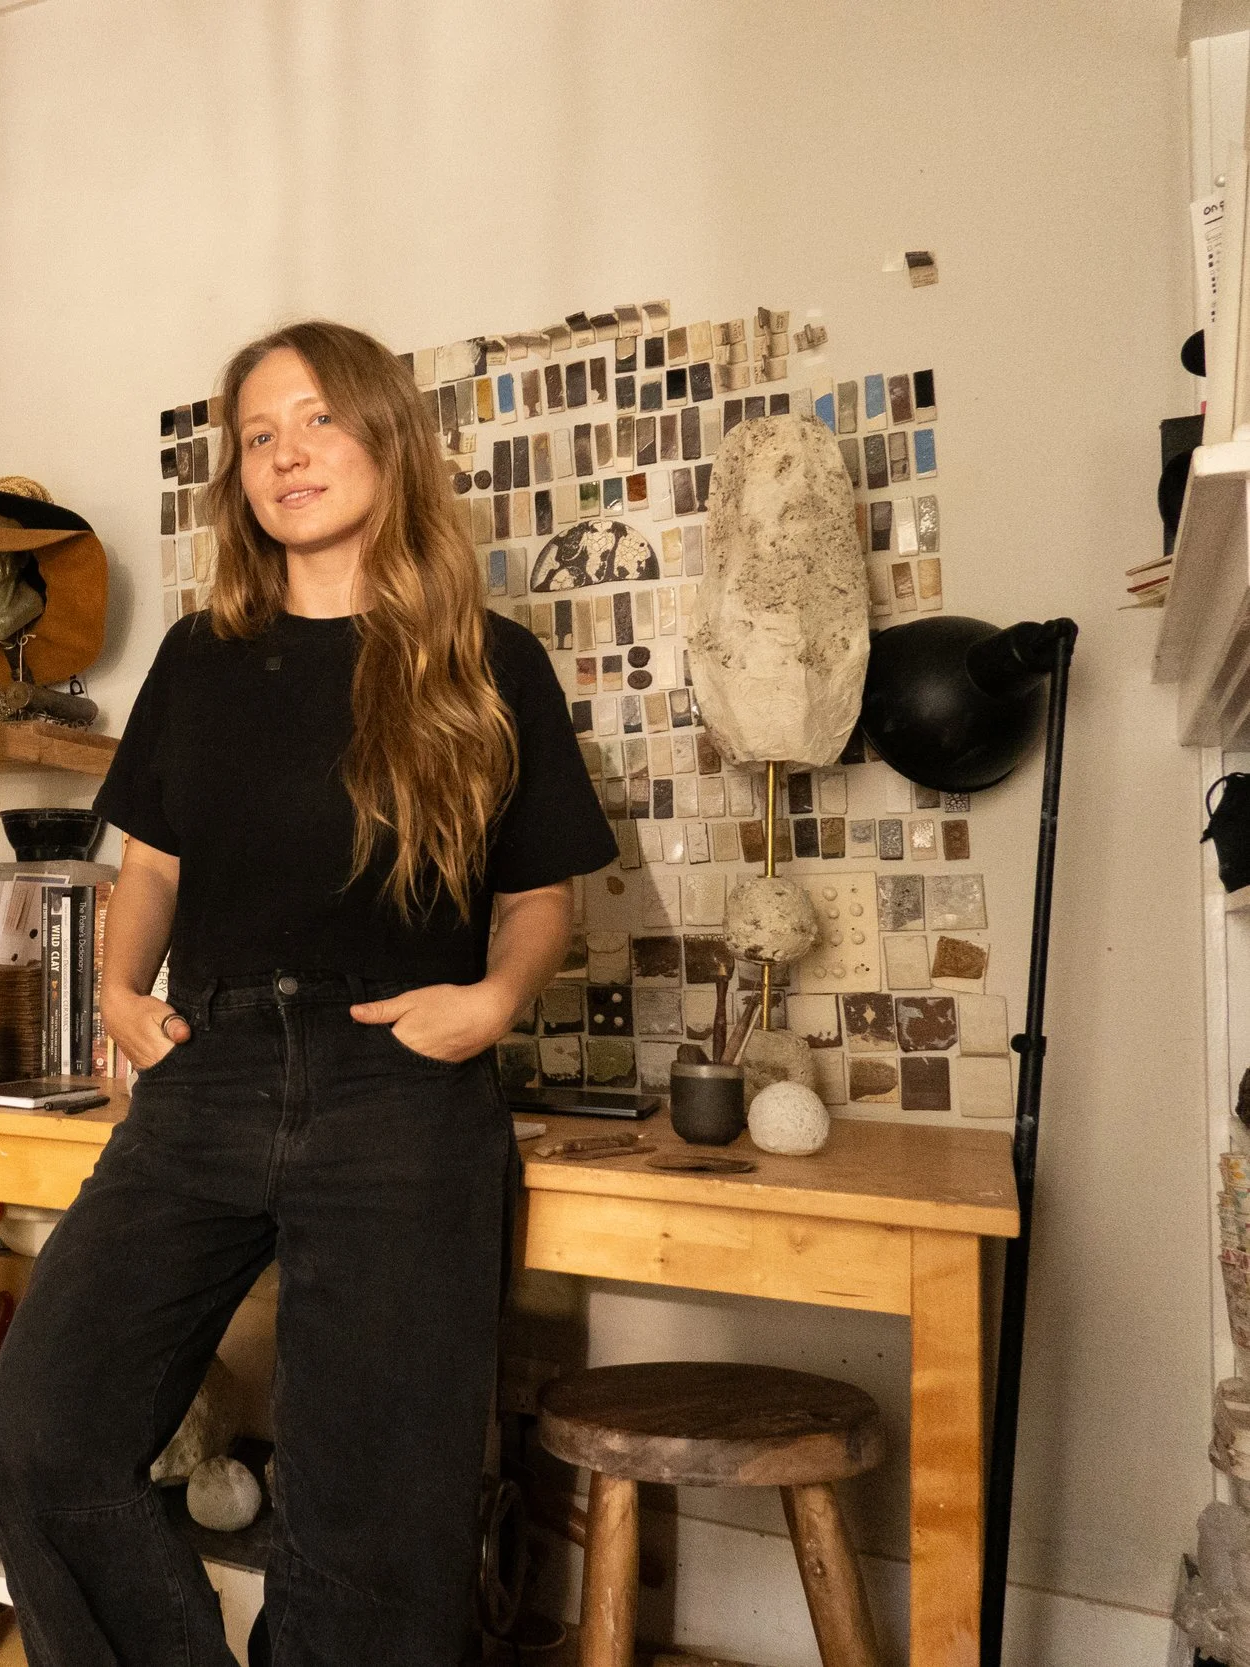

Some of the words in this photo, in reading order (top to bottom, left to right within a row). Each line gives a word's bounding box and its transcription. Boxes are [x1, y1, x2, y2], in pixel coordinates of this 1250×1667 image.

[79, 902, 87, 914] The
[51, 924, 61, 947] WILD
[79, 915, 87, 938] Potter's
[51, 950, 60, 972] CLAY
[77, 939, 87, 973] Dictionary
